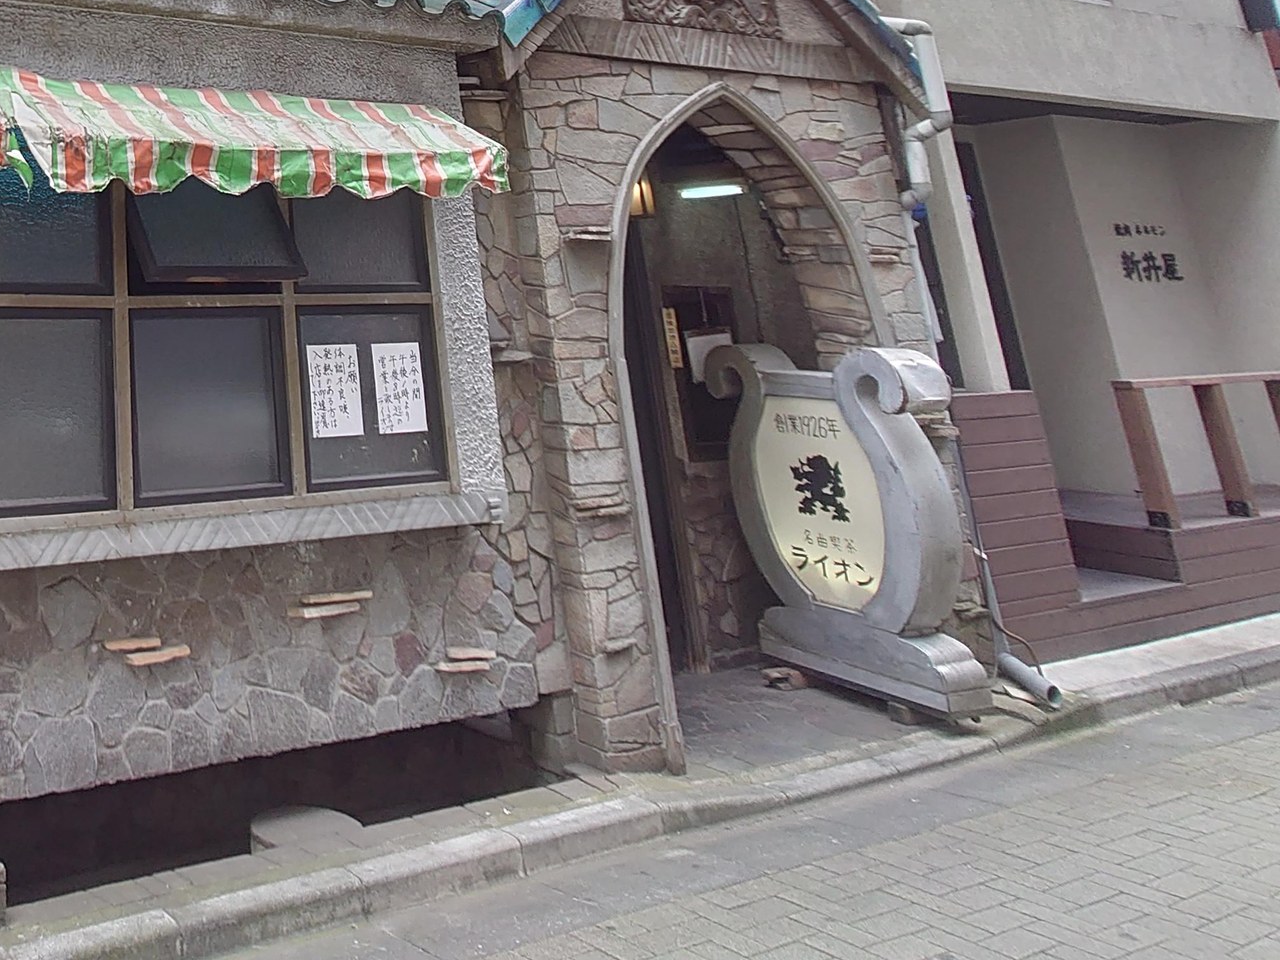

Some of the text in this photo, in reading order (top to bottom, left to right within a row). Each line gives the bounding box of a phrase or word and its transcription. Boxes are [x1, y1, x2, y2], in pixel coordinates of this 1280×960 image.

[1121, 250, 1184, 283] 新井屋
[773, 412, 841, 440] 創業1926年
[803, 528, 858, 555] 名曲喫茶
[790, 544, 875, 587] ライオン
